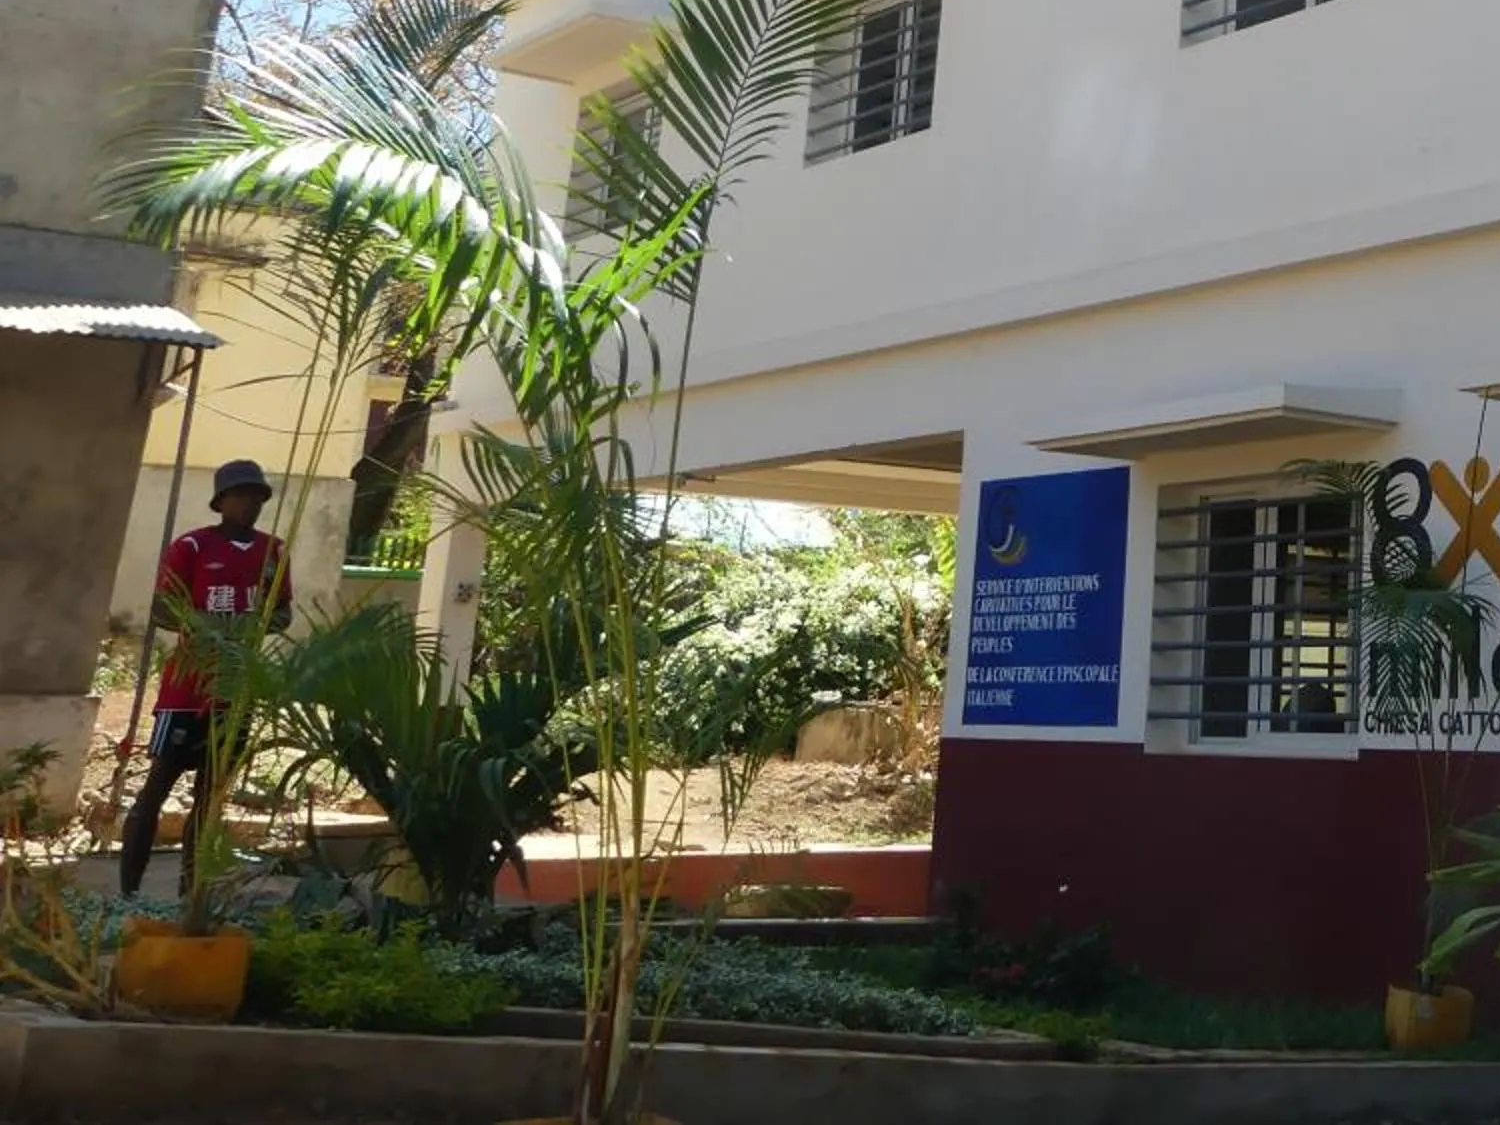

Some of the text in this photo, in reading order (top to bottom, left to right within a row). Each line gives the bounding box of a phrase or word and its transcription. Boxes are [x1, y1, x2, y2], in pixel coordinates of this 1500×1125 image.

[1062, 593, 1077, 610] LE
[1056, 612, 1077, 630] DES
[971, 635, 1014, 654] PEUPLES
